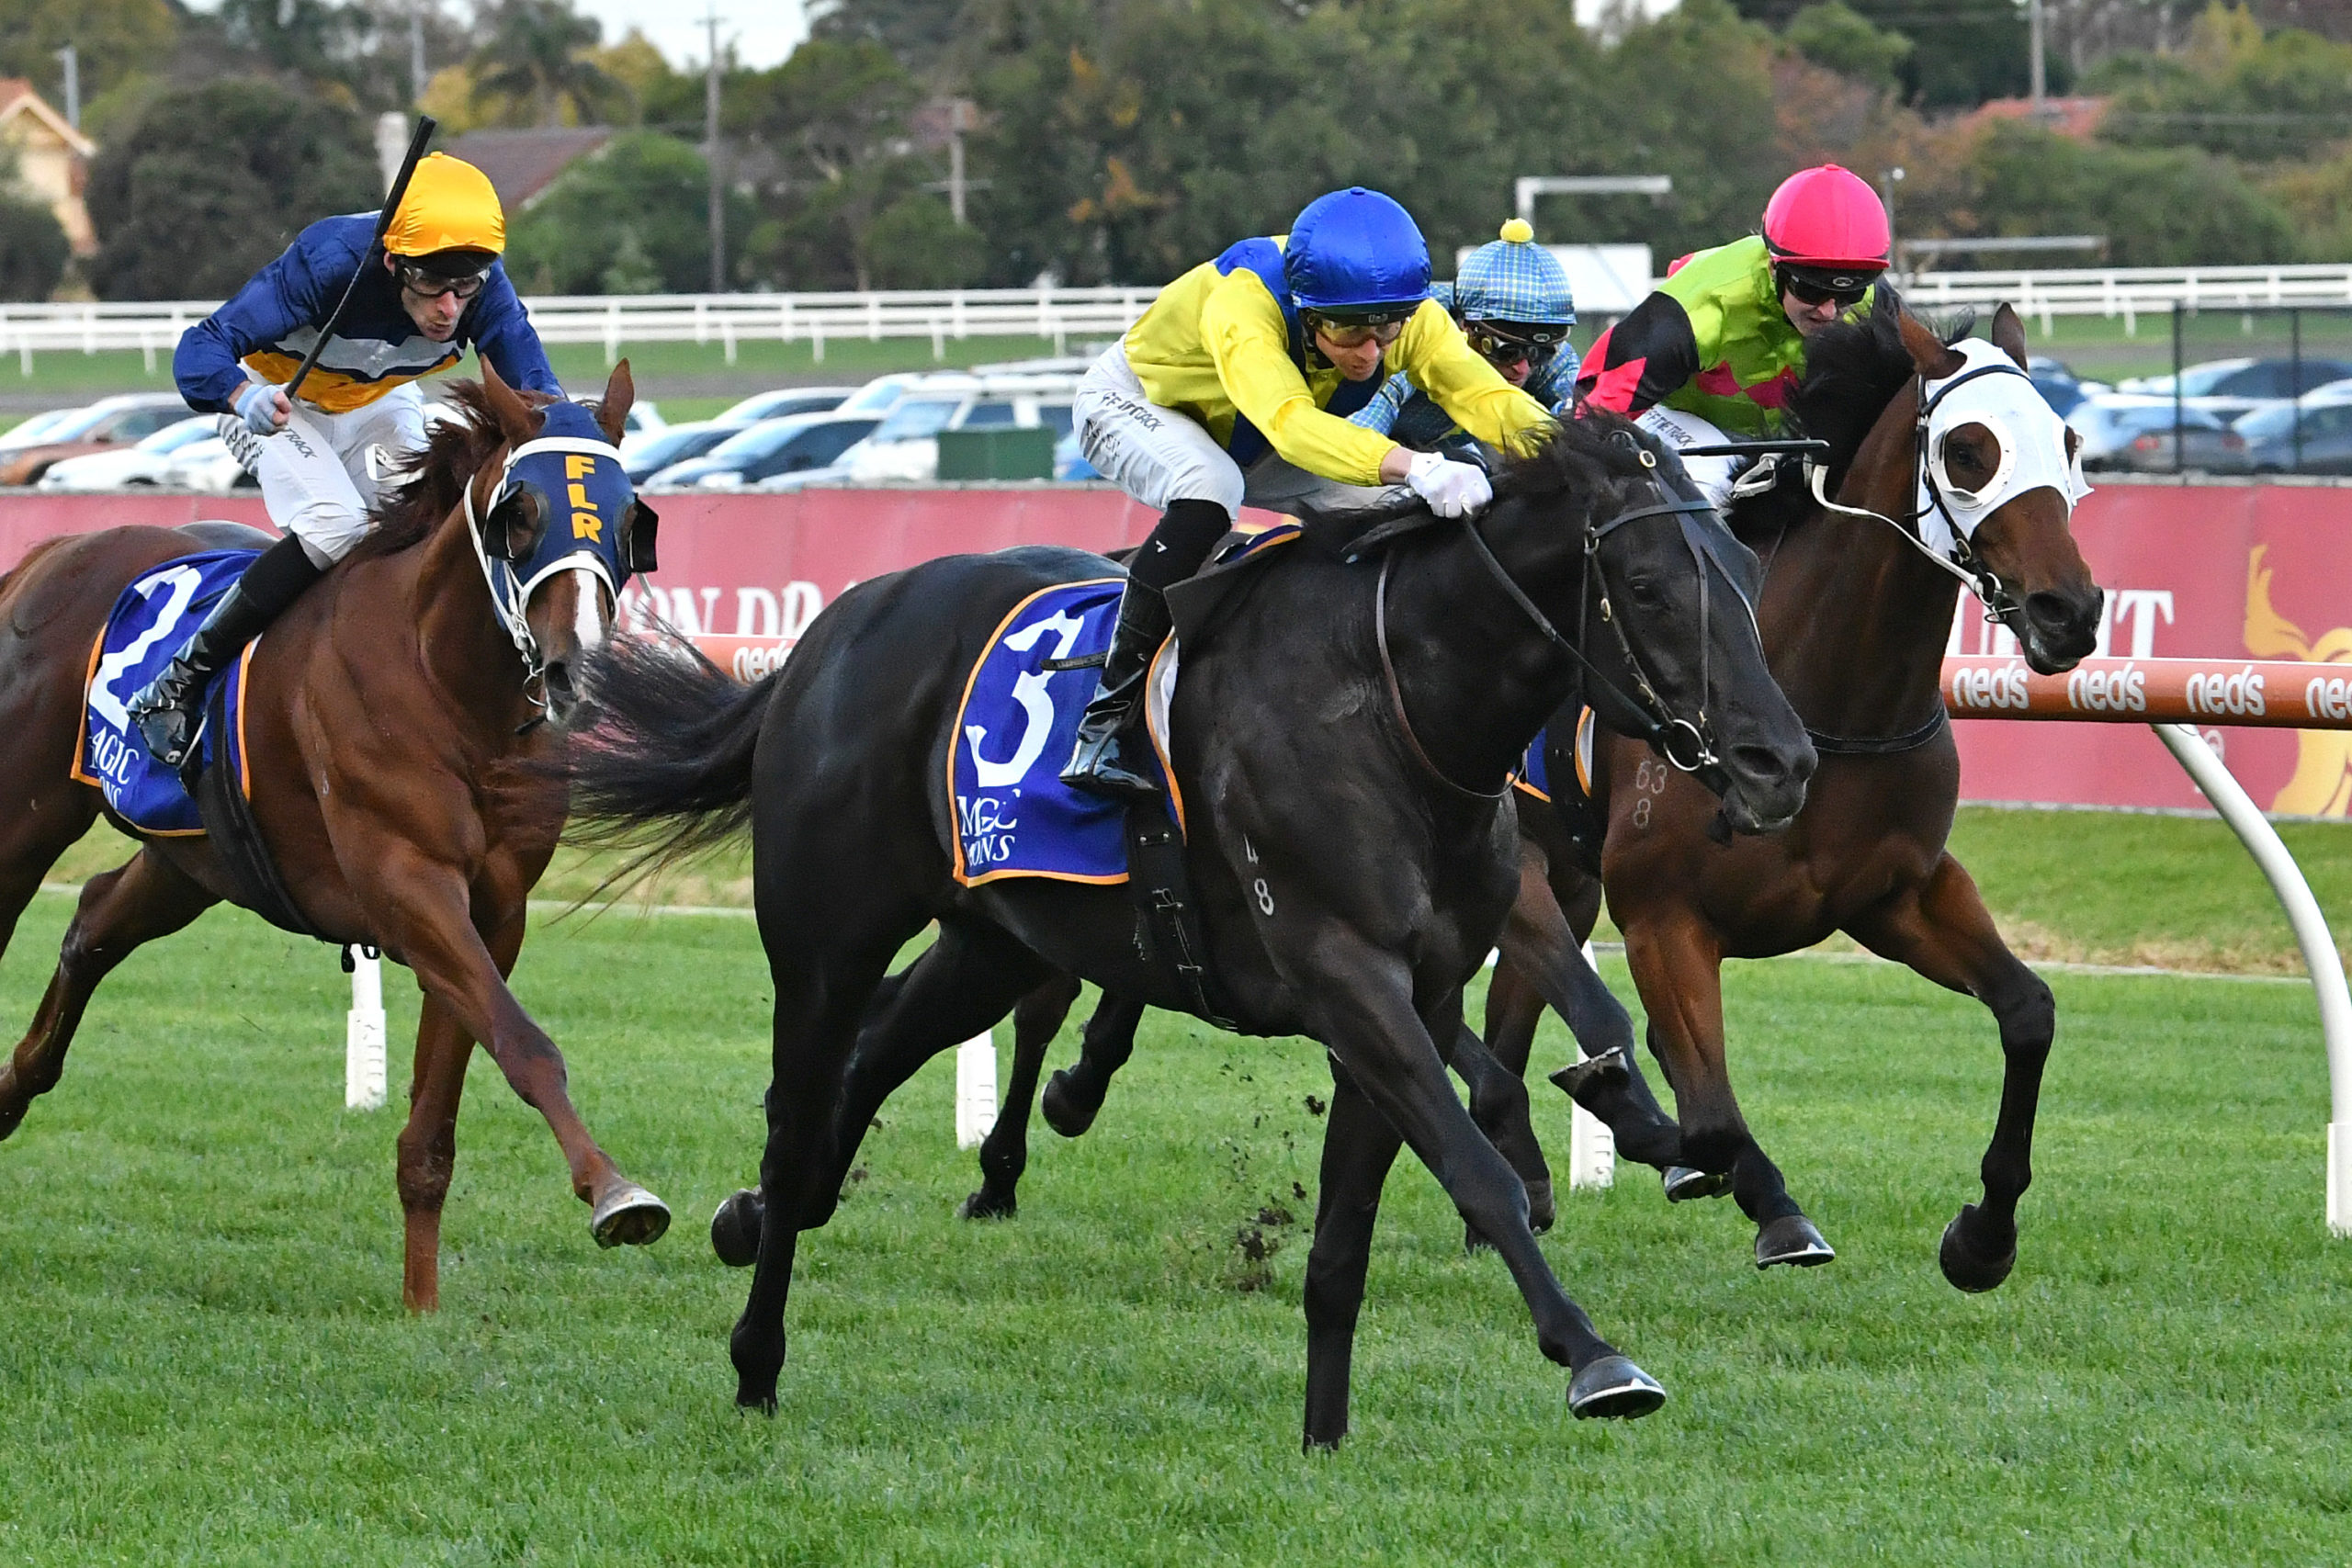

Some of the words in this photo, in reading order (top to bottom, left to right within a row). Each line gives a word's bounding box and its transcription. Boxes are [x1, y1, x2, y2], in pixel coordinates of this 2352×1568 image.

[286, 428, 318, 458] TRACK
[88, 563, 202, 737] 2
[967, 609, 1085, 788] 3
